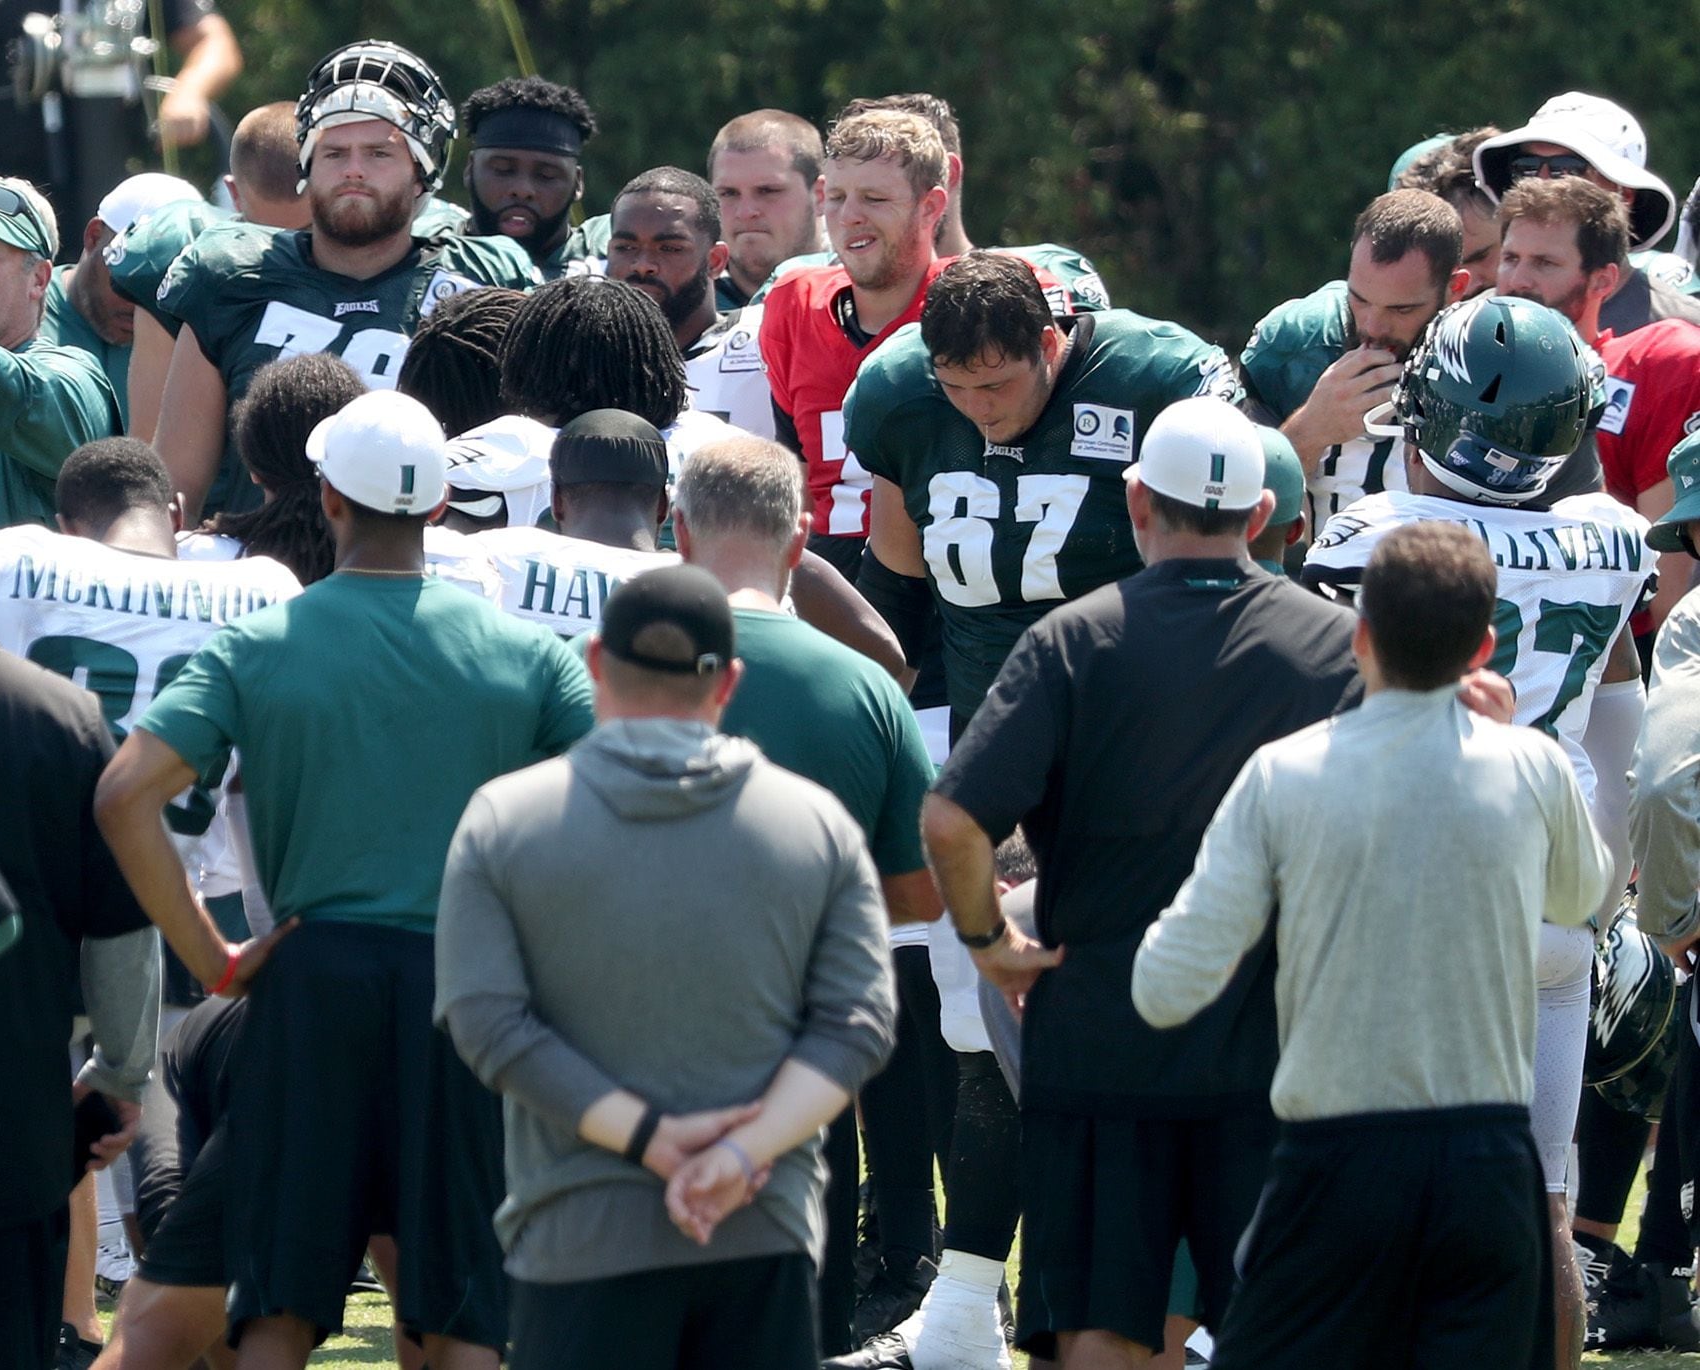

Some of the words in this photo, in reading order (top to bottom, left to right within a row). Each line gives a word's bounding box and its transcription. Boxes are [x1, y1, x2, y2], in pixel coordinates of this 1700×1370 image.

[333, 300, 380, 317] EAGLES
[983, 443, 1024, 464] EAGLES
[1457, 518, 1642, 572] LLIVAN
